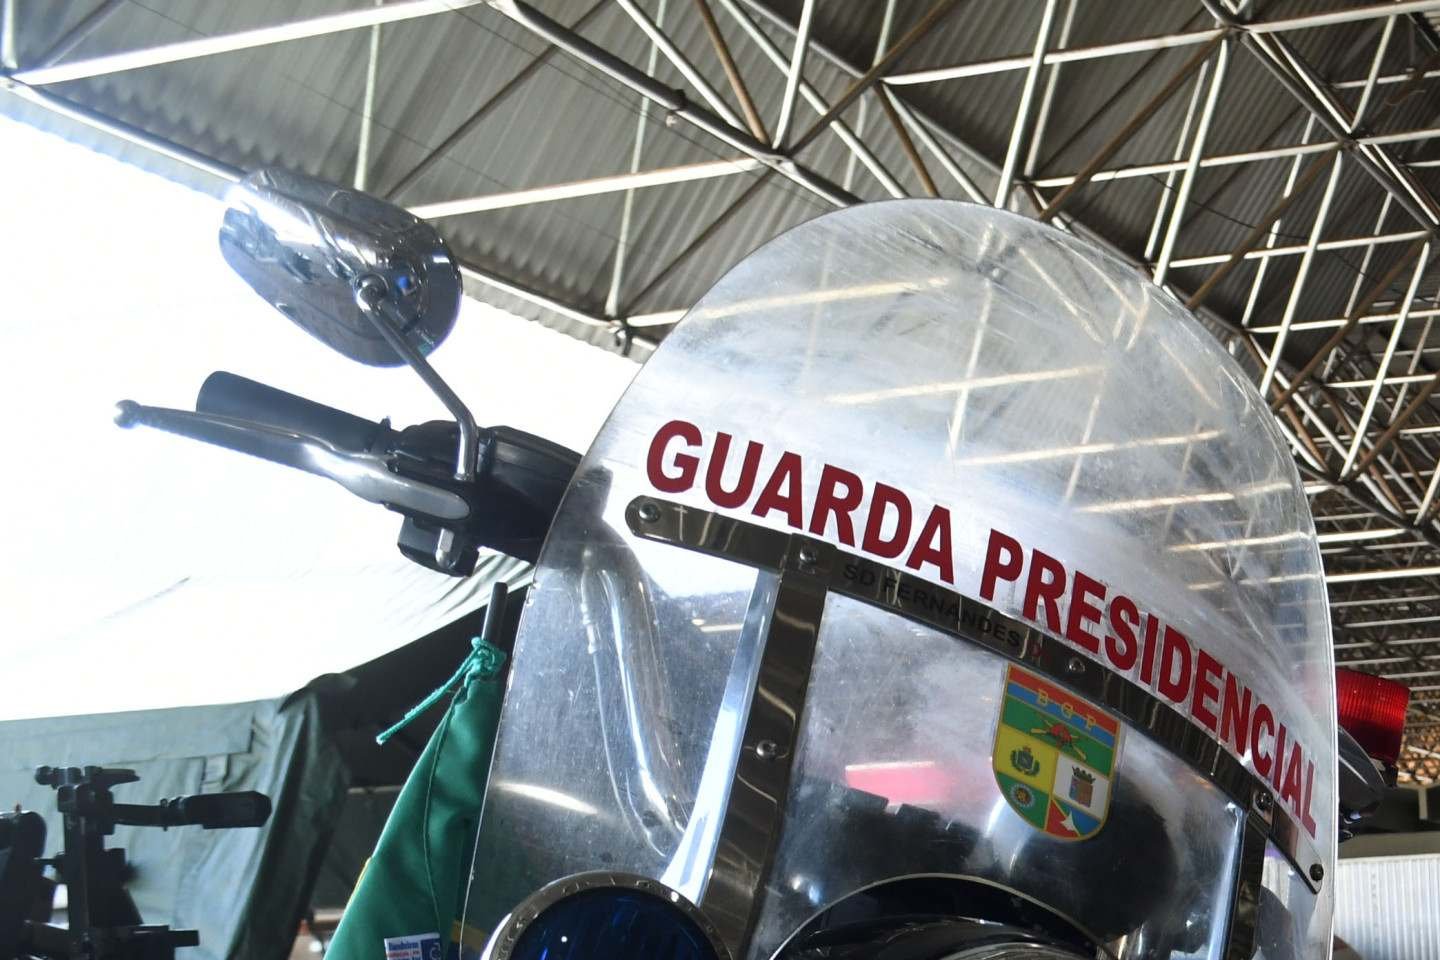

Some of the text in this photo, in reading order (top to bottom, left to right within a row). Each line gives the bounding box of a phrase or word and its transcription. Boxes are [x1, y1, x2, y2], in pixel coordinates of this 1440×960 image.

[647, 420, 1317, 838] GUARDA PRESIDENCIAL
[843, 563, 876, 587] SD
[882, 576, 1021, 648] FERNANDES
